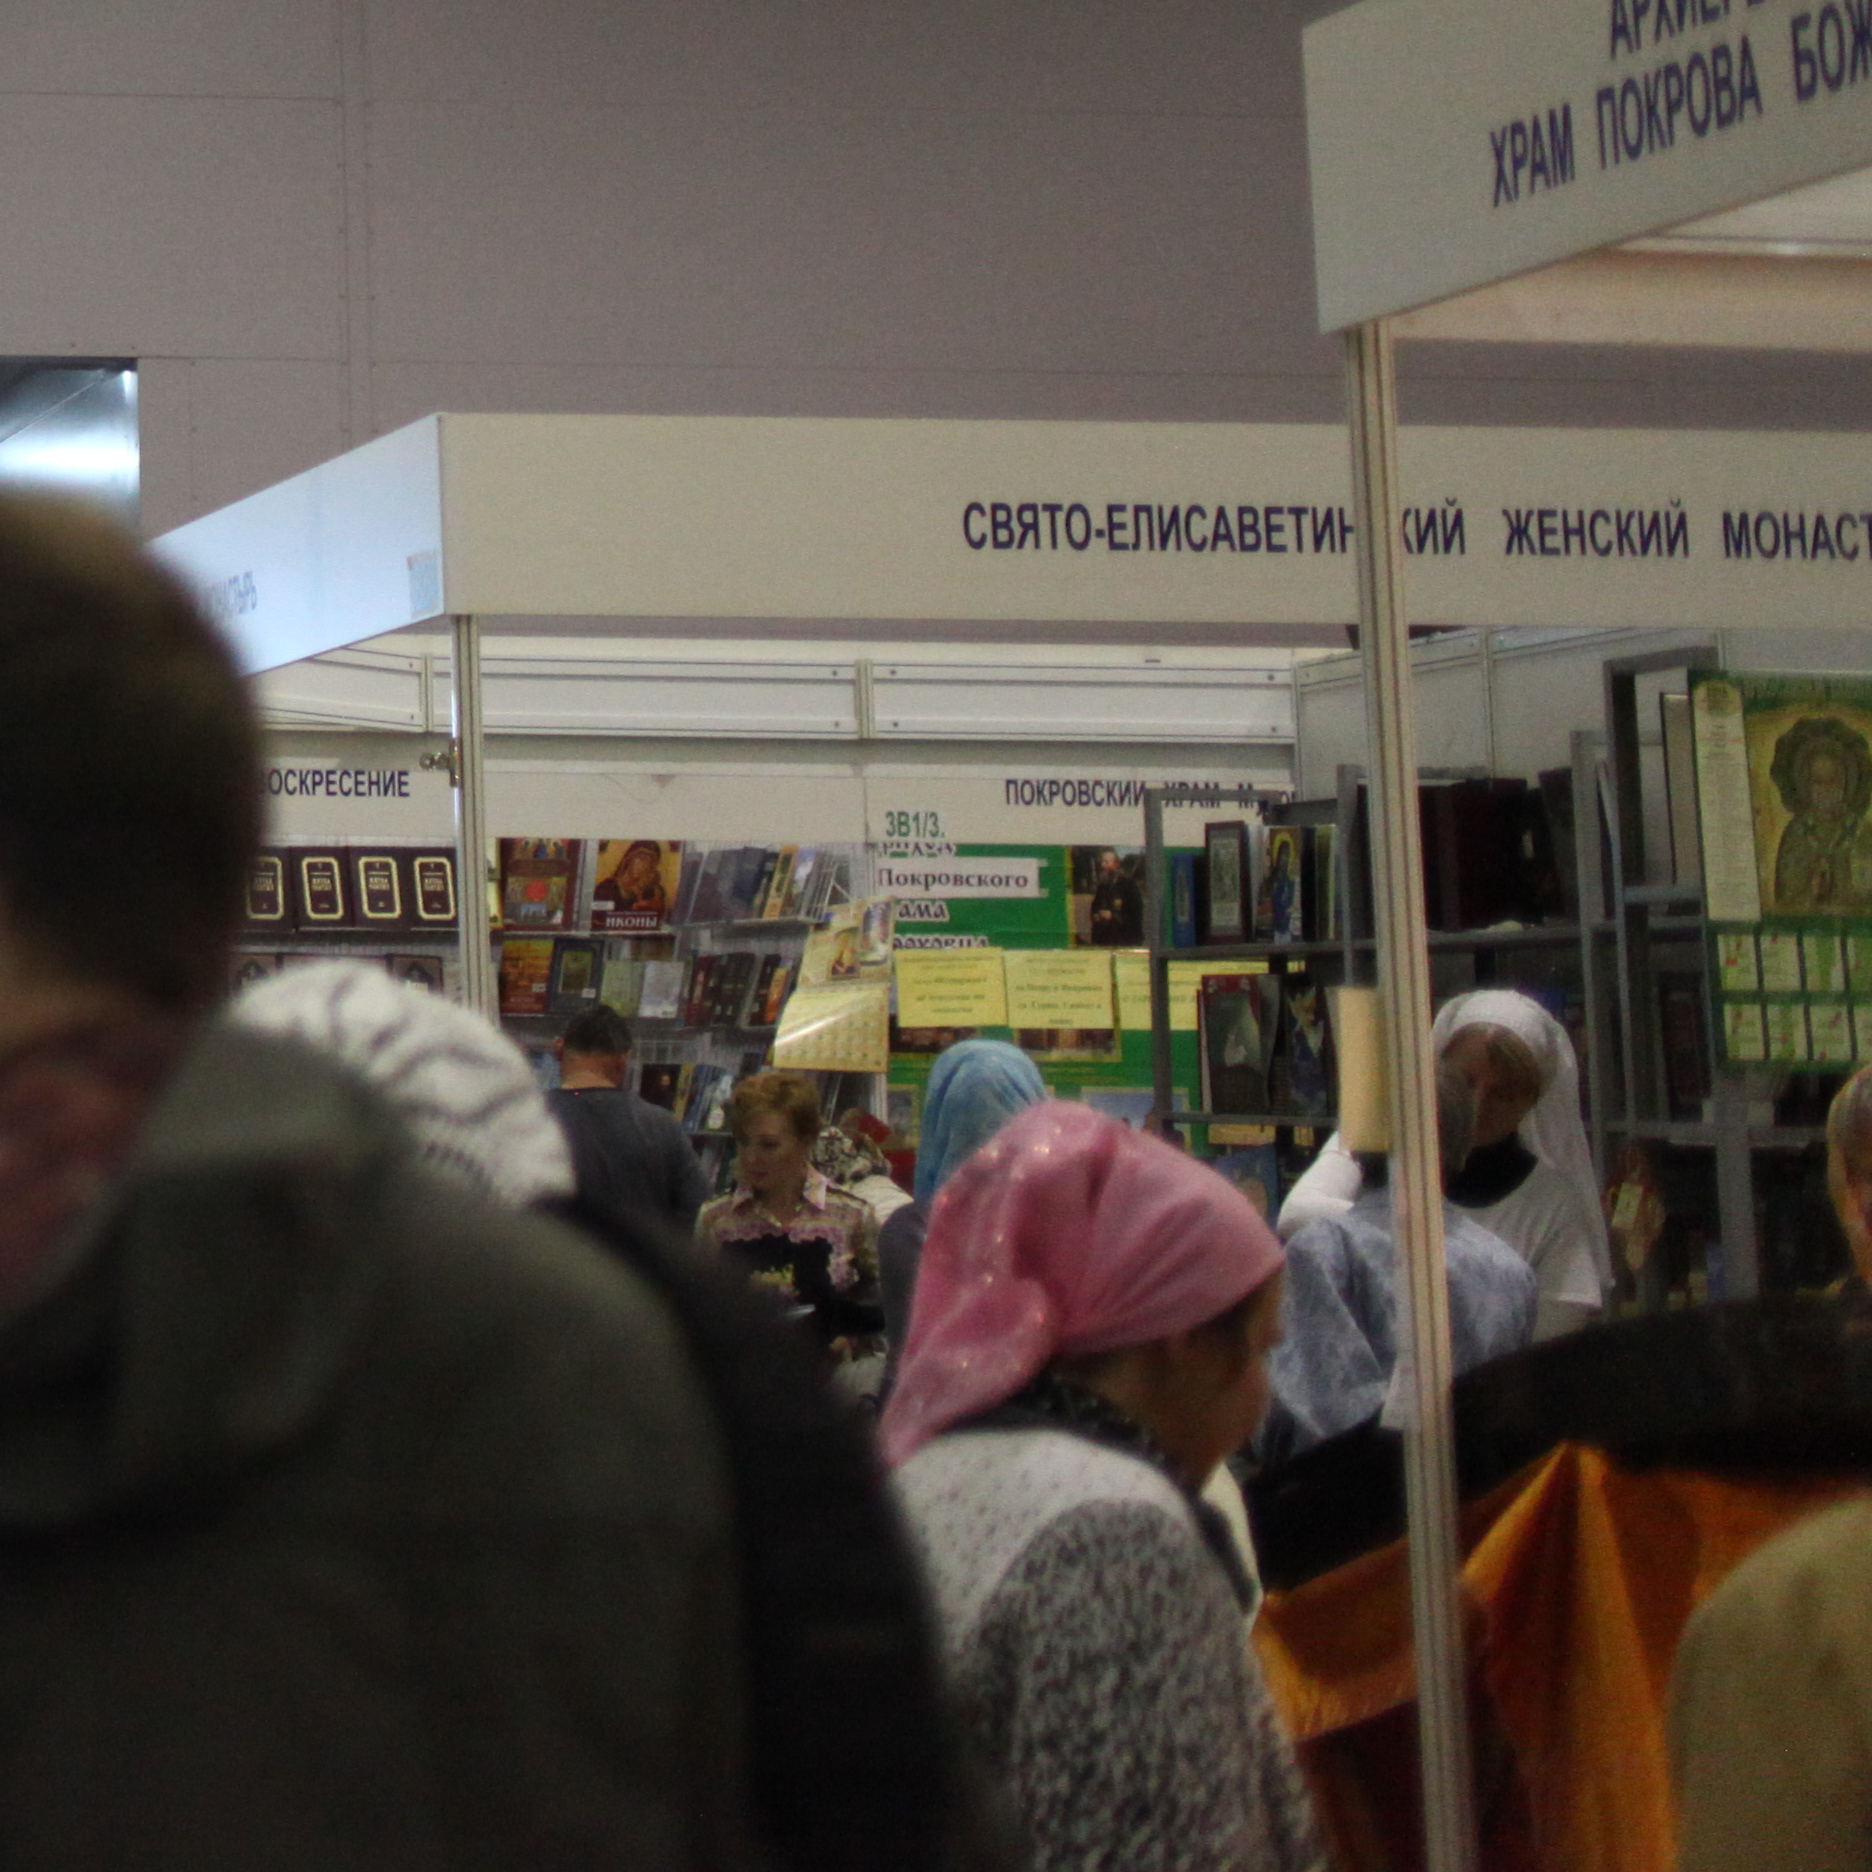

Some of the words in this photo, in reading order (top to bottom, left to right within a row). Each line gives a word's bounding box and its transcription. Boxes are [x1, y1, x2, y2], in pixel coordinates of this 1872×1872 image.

[1489, 103, 1575, 208] ХРАМ
[1595, 33, 1763, 170] ПОКРОВА
[962, 496, 1466, 556] СВЯТО-ЕЛИСАВЕТИНИЙ
[1502, 498, 1691, 558] ЖЕНСКИЙ
[267, 768, 411, 797] ОСКРЕСЕНИЕ
[878, 868, 1029, 892] Покровского
[605, 916, 658, 928] ИКОНЫ
